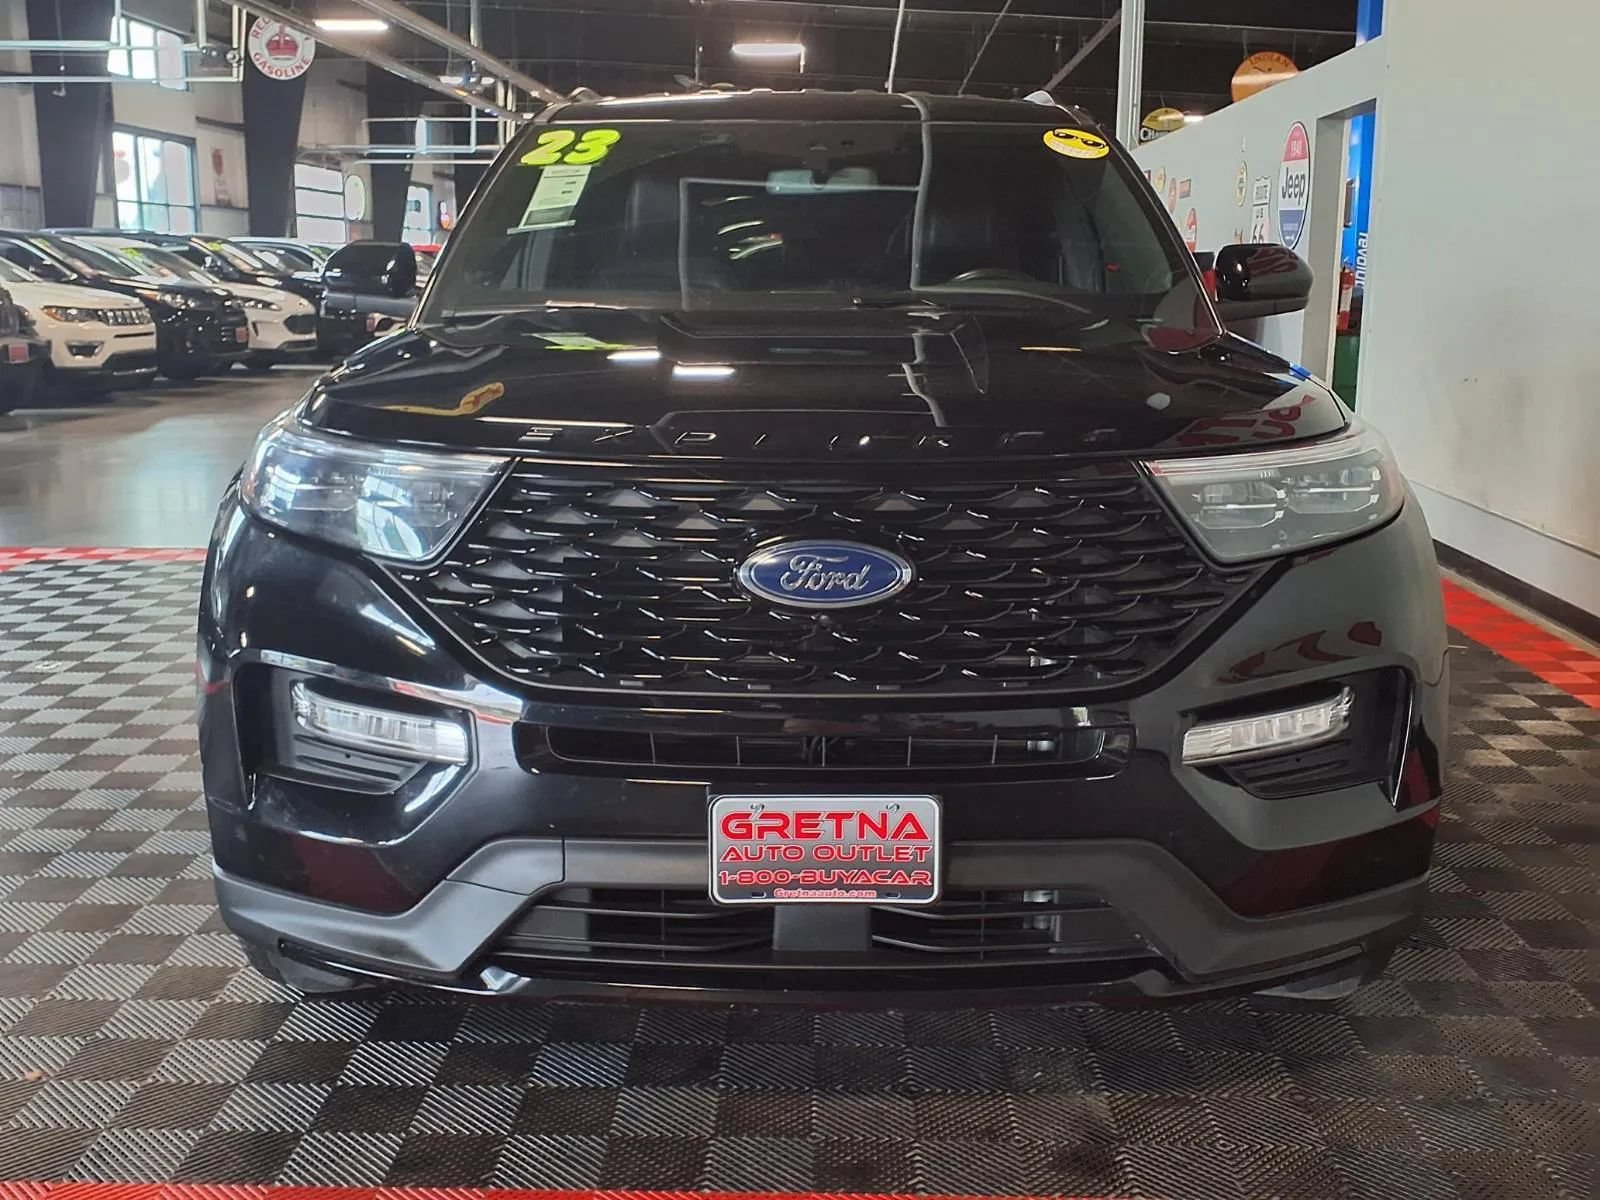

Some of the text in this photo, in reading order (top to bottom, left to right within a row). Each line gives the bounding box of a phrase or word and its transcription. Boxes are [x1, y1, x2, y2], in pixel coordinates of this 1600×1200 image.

[253, 52, 311, 78] GASOLINE
[520, 129, 621, 166] 23
[1281, 166, 1306, 206] Jeep
[780, 554, 871, 591] Ford
[720, 811, 931, 841] GRETNA
[719, 845, 933, 862] AUTO OUTLET
[719, 870, 932, 886] 1-800-BUYACAR
[774, 888, 877, 899] Gretnaauto.com
